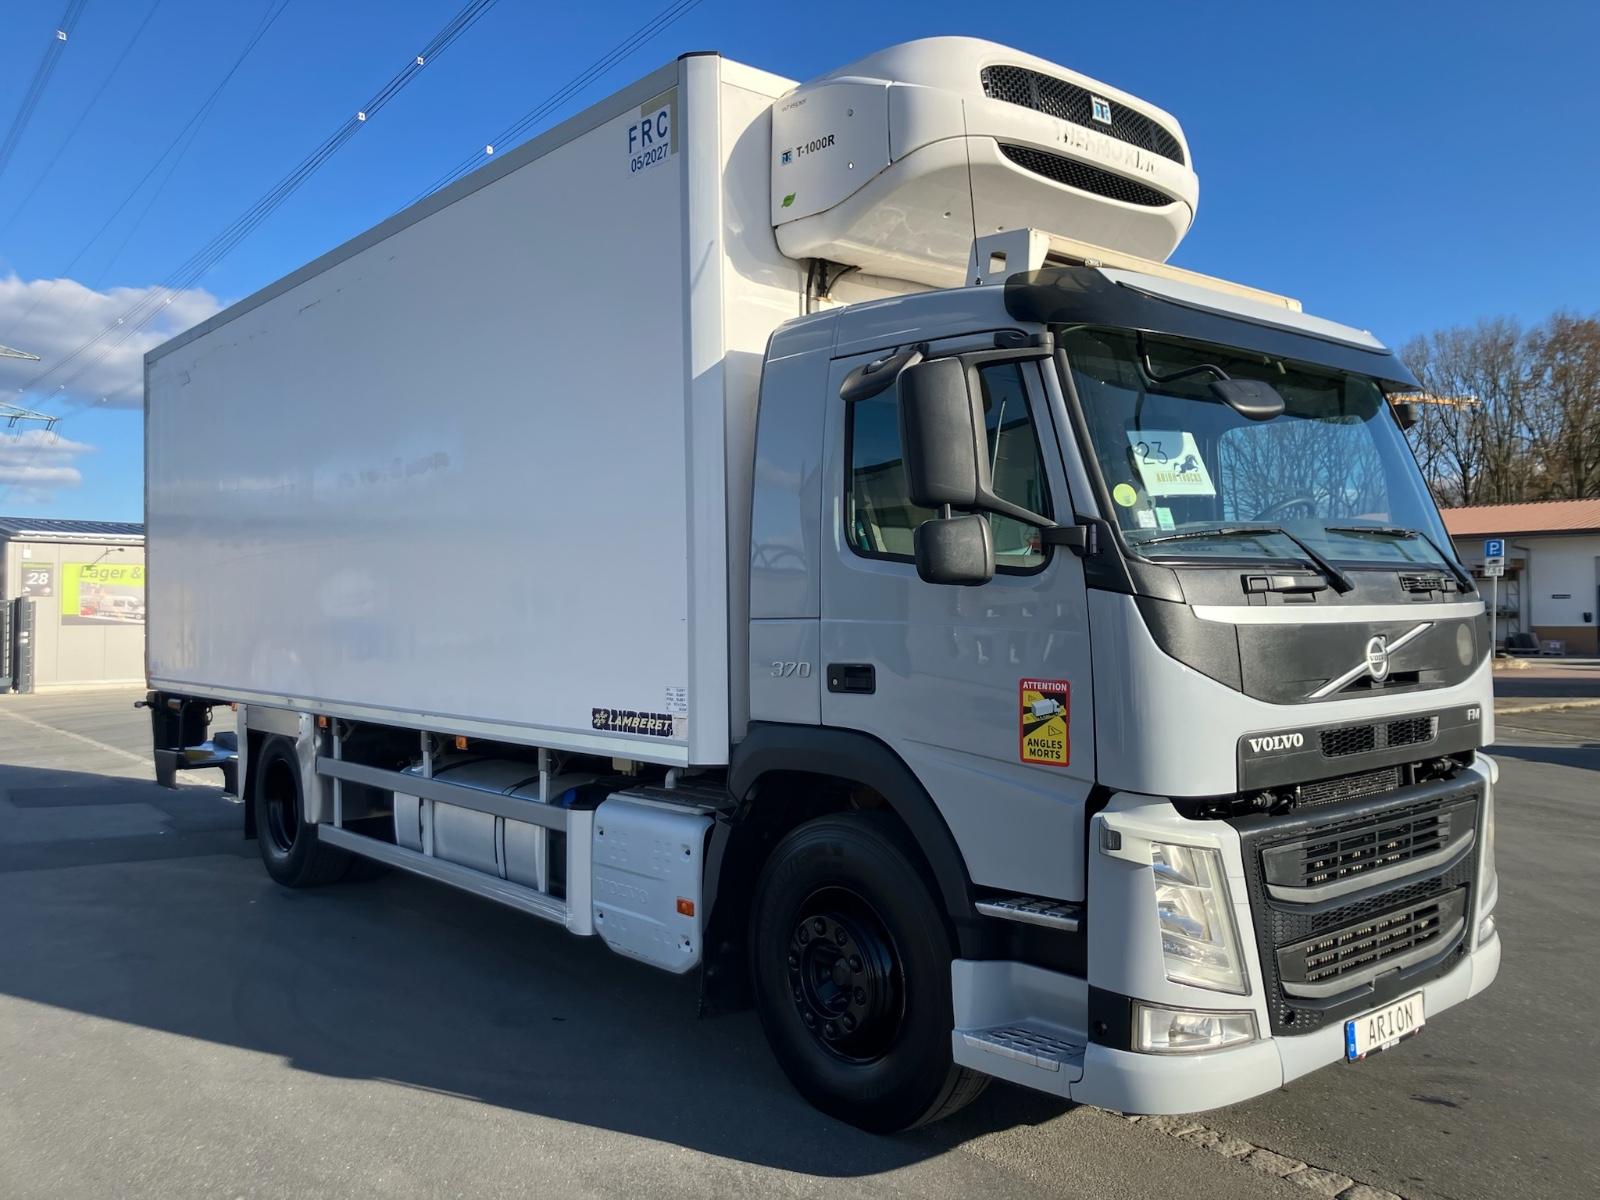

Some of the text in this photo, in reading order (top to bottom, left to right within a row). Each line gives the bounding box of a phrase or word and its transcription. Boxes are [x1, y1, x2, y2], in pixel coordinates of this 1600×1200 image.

[628, 110, 669, 154] FRC
[796, 134, 836, 158] T-1000R
[631, 143, 669, 173] 05/2027
[1136, 441, 1168, 465] 23
[26, 572, 49, 585] 28
[770, 661, 811, 678] 370
[1023, 681, 1067, 692] ATTENTION
[1466, 708, 1480, 721] FM
[1027, 738, 1062, 750] ANGLES
[1249, 733, 1304, 753] VOLVO
[1029, 748, 1061, 759] MORTS
[1369, 1001, 1414, 1045] ARION
